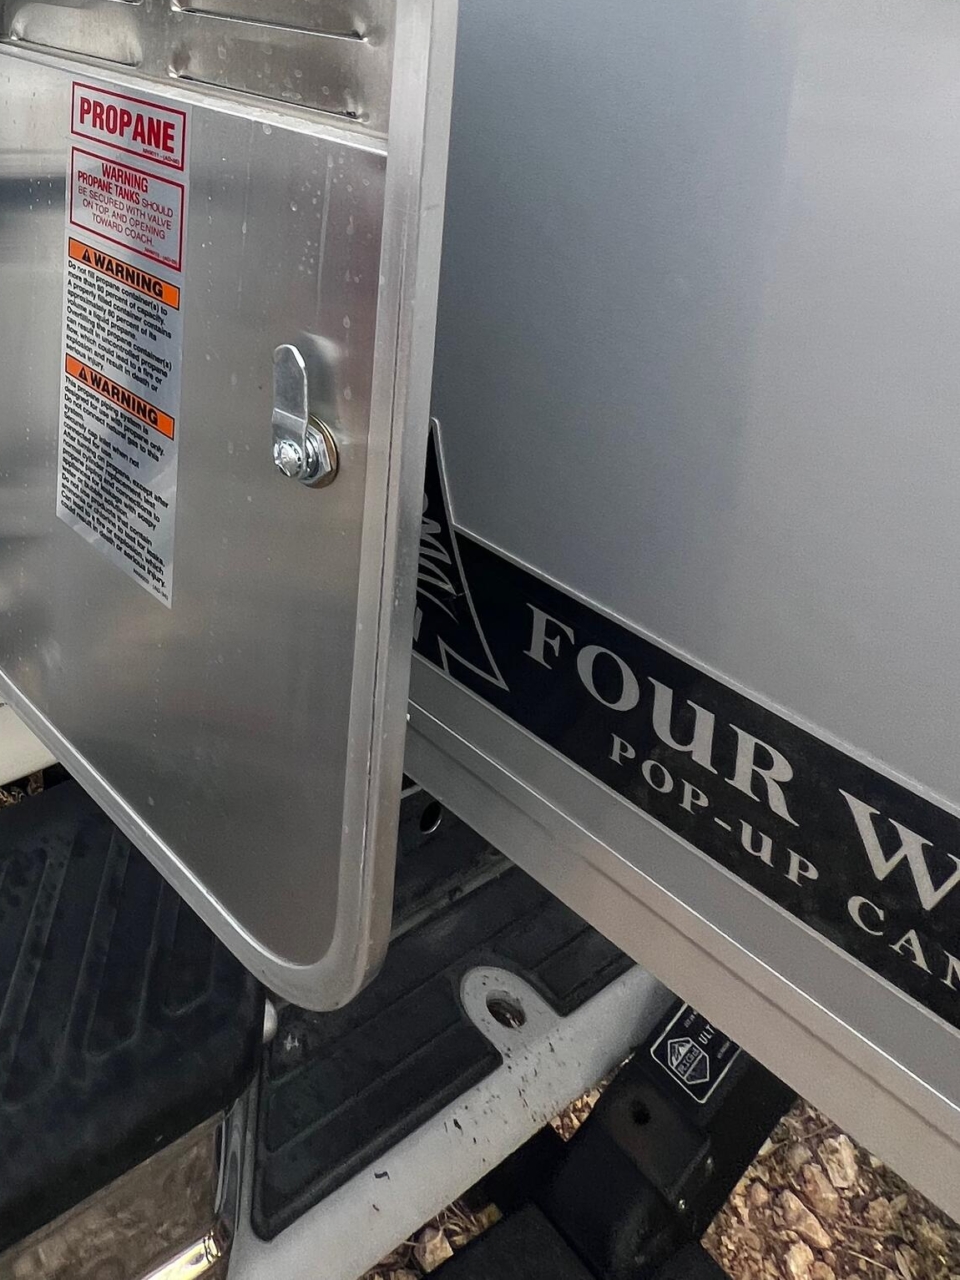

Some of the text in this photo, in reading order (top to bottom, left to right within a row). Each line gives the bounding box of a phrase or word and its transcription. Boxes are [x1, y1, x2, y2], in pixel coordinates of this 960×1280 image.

[79, 96, 176, 154] PROPANE
[77, 170, 174, 220] PROPANE TANKS SHOULD
[101, 162, 148, 194] WARNING
[78, 185, 172, 231] BE SECURED WITH VALVE
[82, 197, 93, 210] ON
[112, 209, 127, 225] AND
[128, 216, 166, 241] OPENING
[92, 212, 123, 235] TOWARD
[68, 260, 76, 271] Do
[96, 275, 120, 294] propane
[161, 306, 168, 317] to
[68, 270, 82, 283] more
[83, 277, 96, 290] than
[105, 288, 128, 309] percent
[129, 300, 136, 311] of
[93, 251, 164, 299] WARNING
[68, 278, 72, 287] A
[73, 281, 96, 301] properly
[113, 302, 142, 324] container
[143, 317, 172, 340] contains
[116, 313, 139, 334] percent
[140, 326, 148, 337] of
[89, 370, 158, 427] WARNING
[522, 602, 800, 827] FOUR
[608, 733, 820, 888] POP-UP
